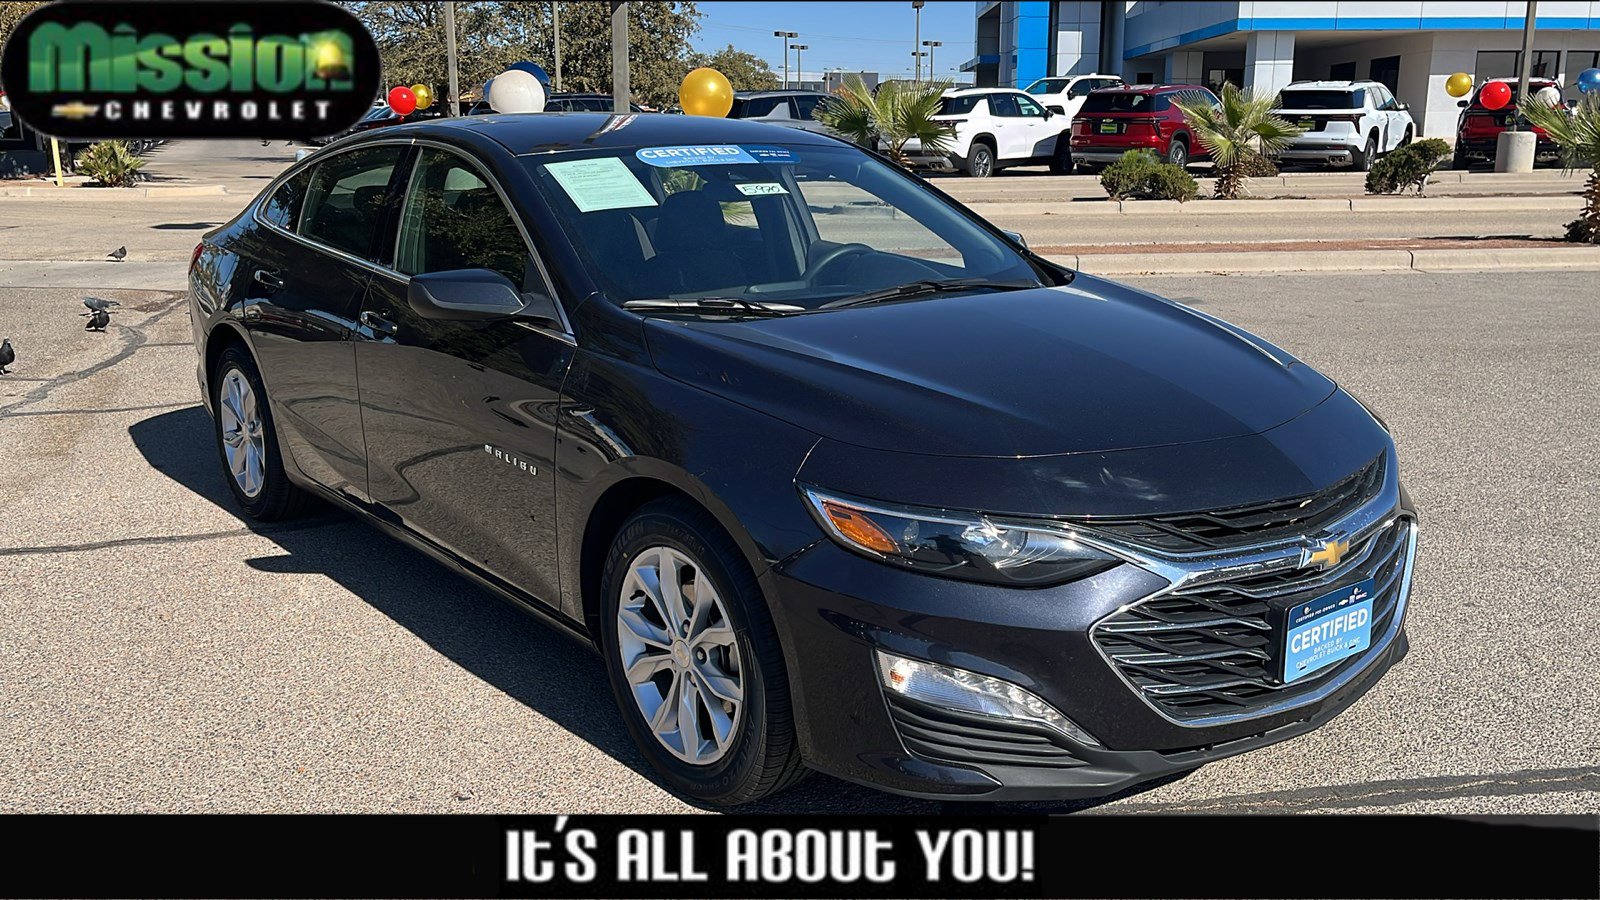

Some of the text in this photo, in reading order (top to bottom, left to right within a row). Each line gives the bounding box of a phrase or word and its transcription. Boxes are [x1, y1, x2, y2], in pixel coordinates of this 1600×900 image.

[641, 147, 740, 159] CERTIFIED
[484, 444, 537, 476] MALIBU
[1291, 608, 1368, 653] CERTIFIED
[1313, 637, 1344, 654] BACKED BY
